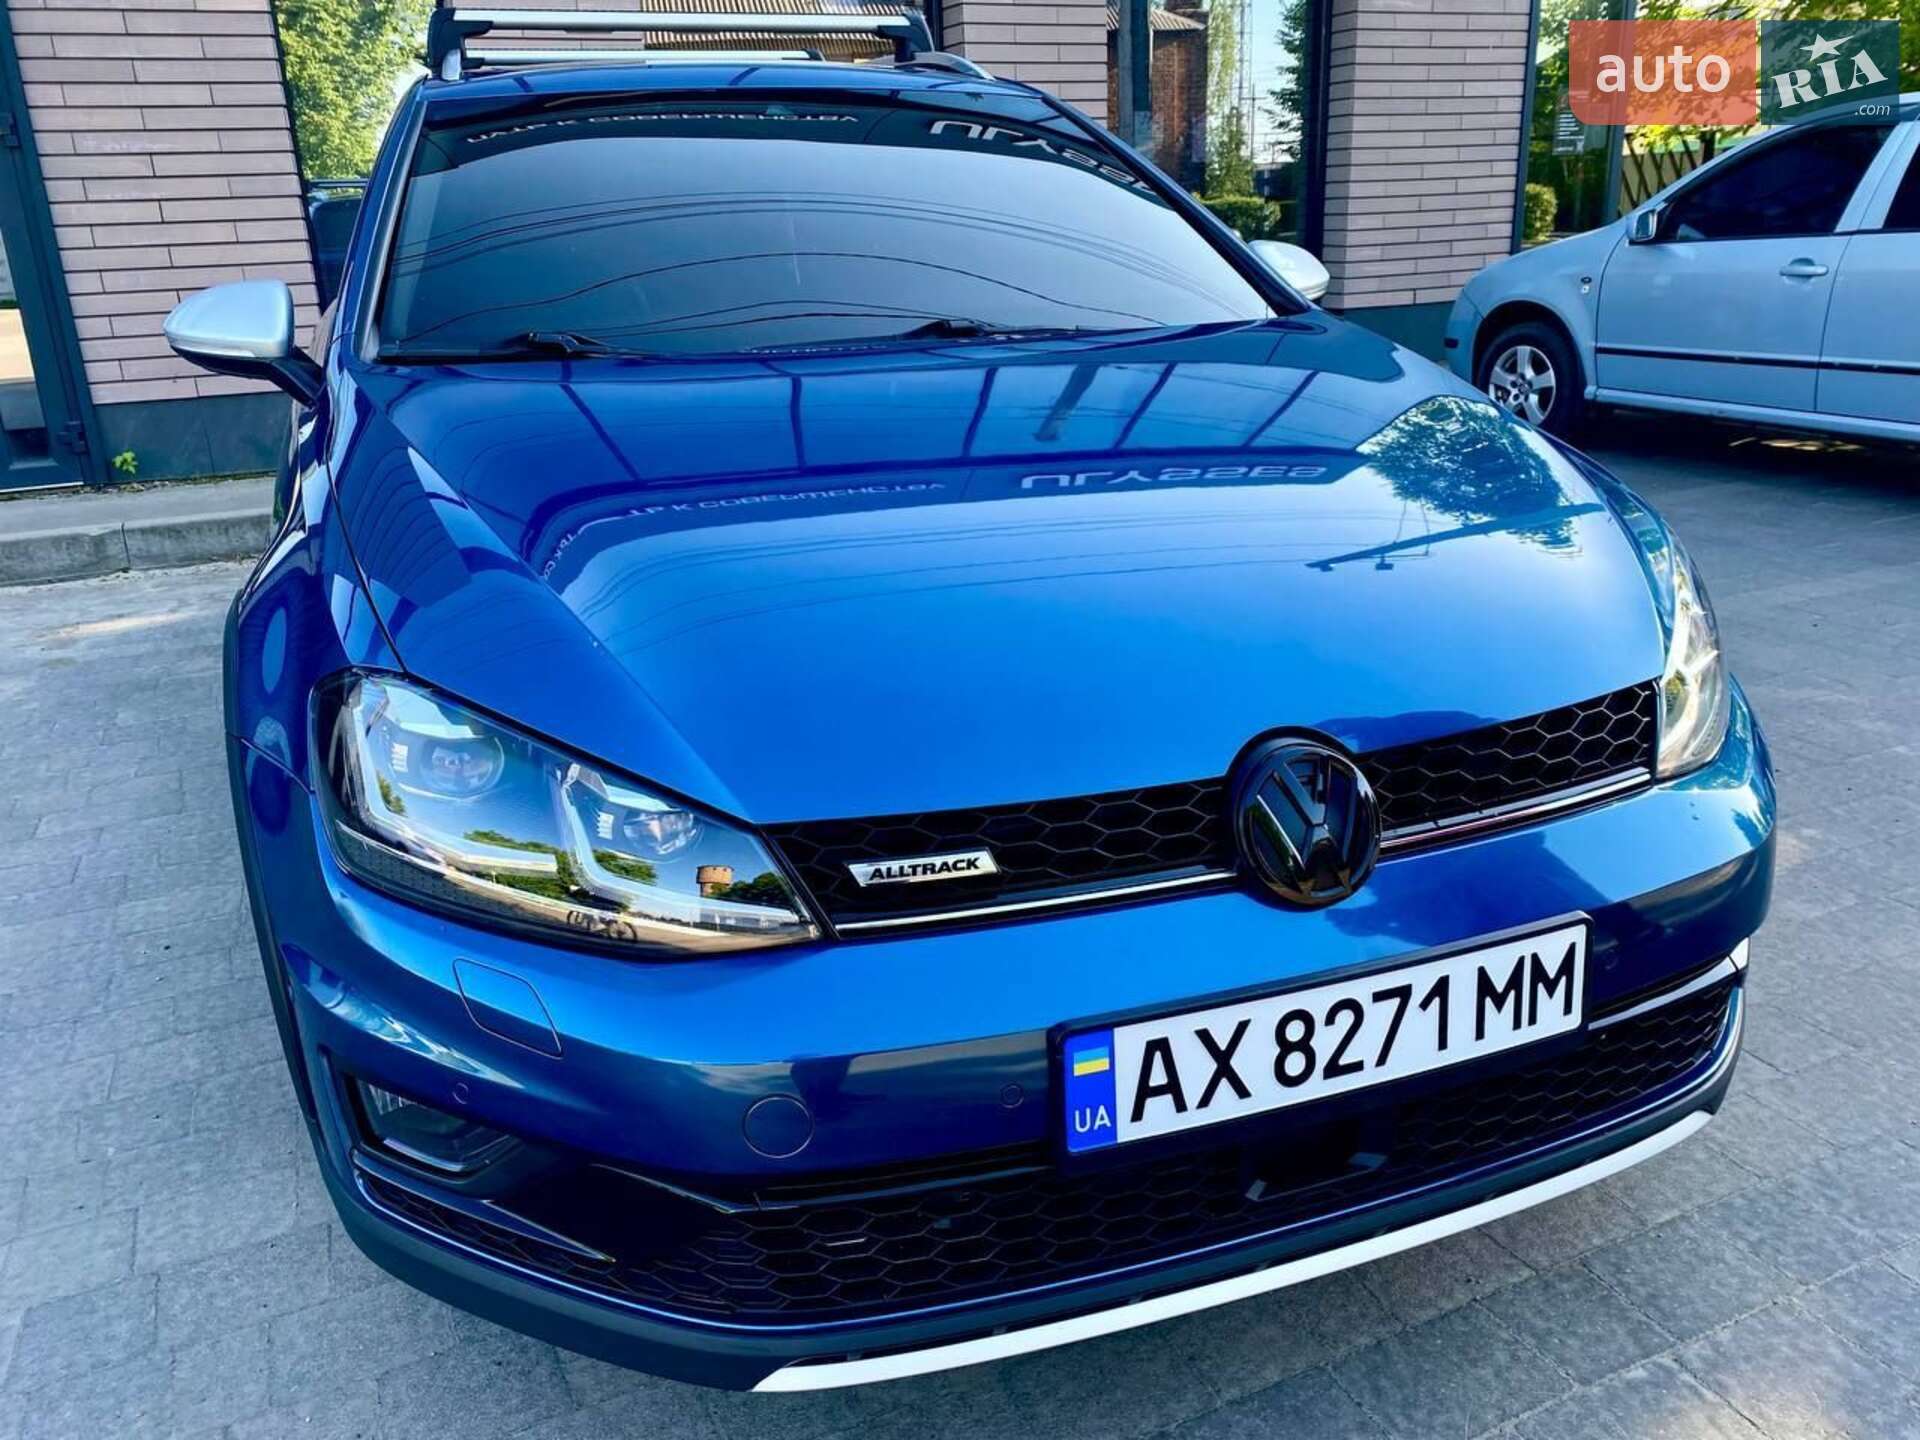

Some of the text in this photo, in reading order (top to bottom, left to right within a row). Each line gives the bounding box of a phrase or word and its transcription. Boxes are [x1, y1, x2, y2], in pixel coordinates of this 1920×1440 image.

[869, 857, 981, 881] ALLTRACK
[1130, 942, 1577, 1123] AX 8271 MM
[1074, 1104, 1112, 1133] UA
